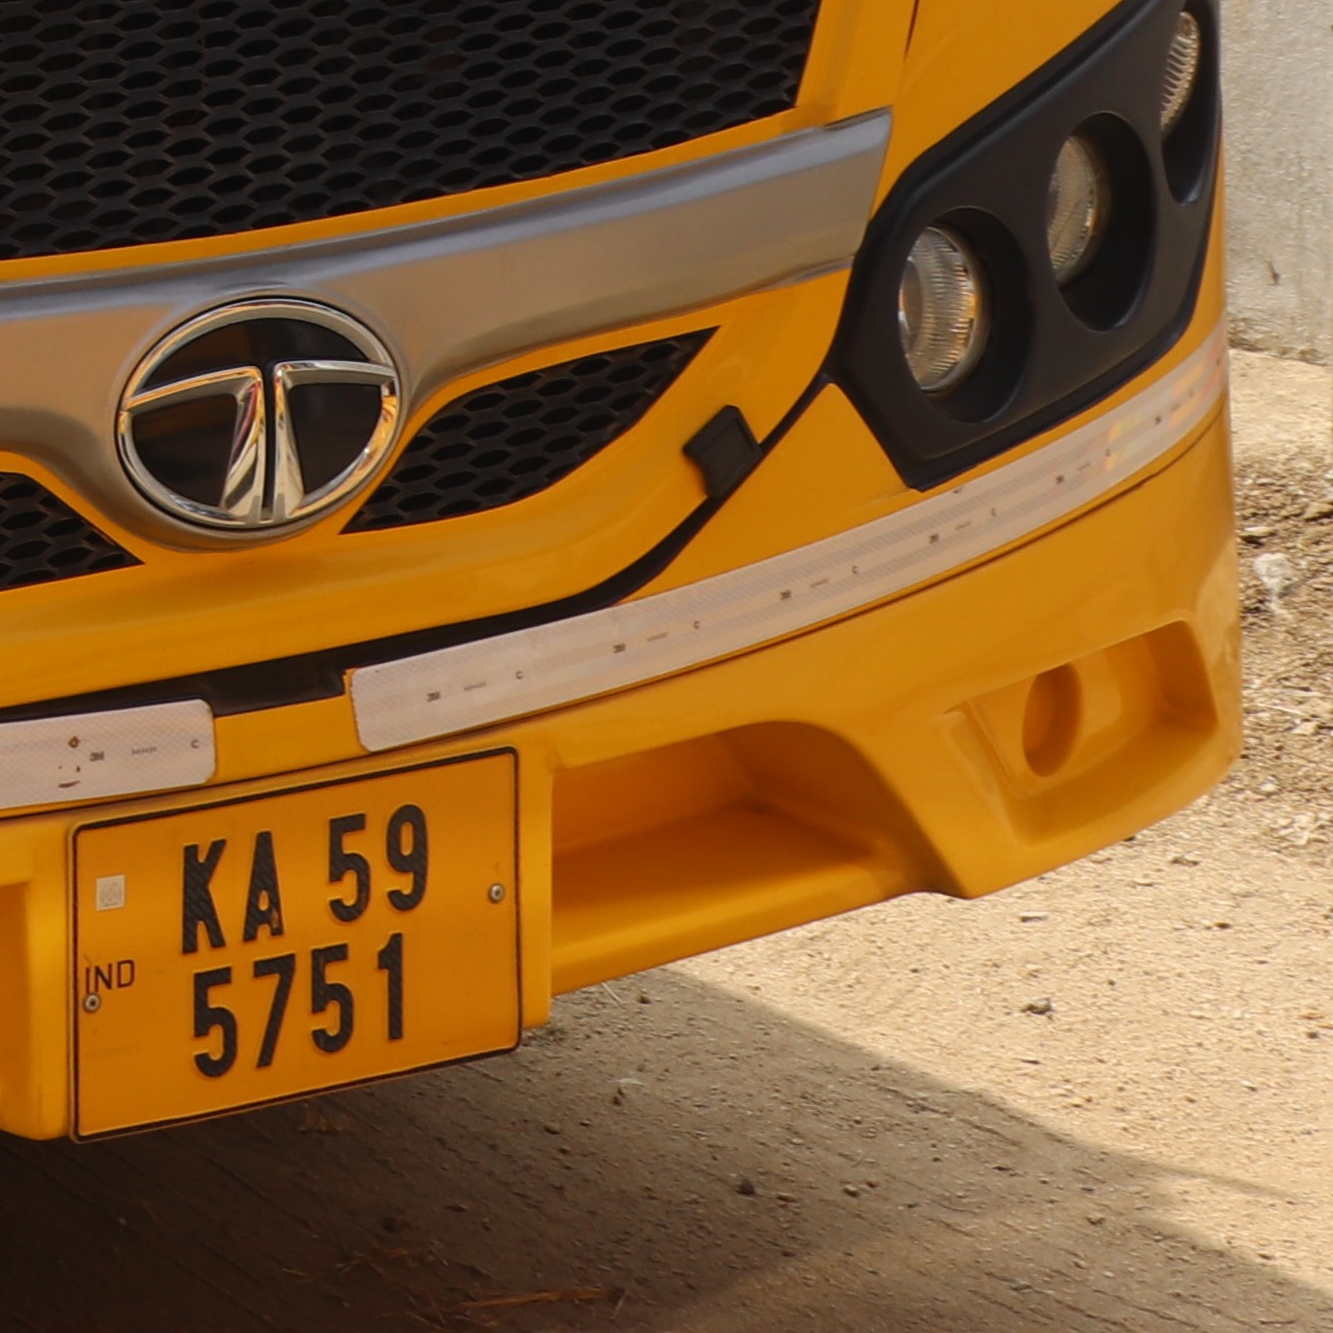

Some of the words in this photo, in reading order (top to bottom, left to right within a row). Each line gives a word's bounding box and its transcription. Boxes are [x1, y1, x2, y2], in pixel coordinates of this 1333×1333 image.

[190, 739, 199, 749] C
[181, 829, 284, 955] KA
[327, 802, 429, 924] 59
[84, 958, 135, 995] IND
[192, 931, 405, 1079] 5751
